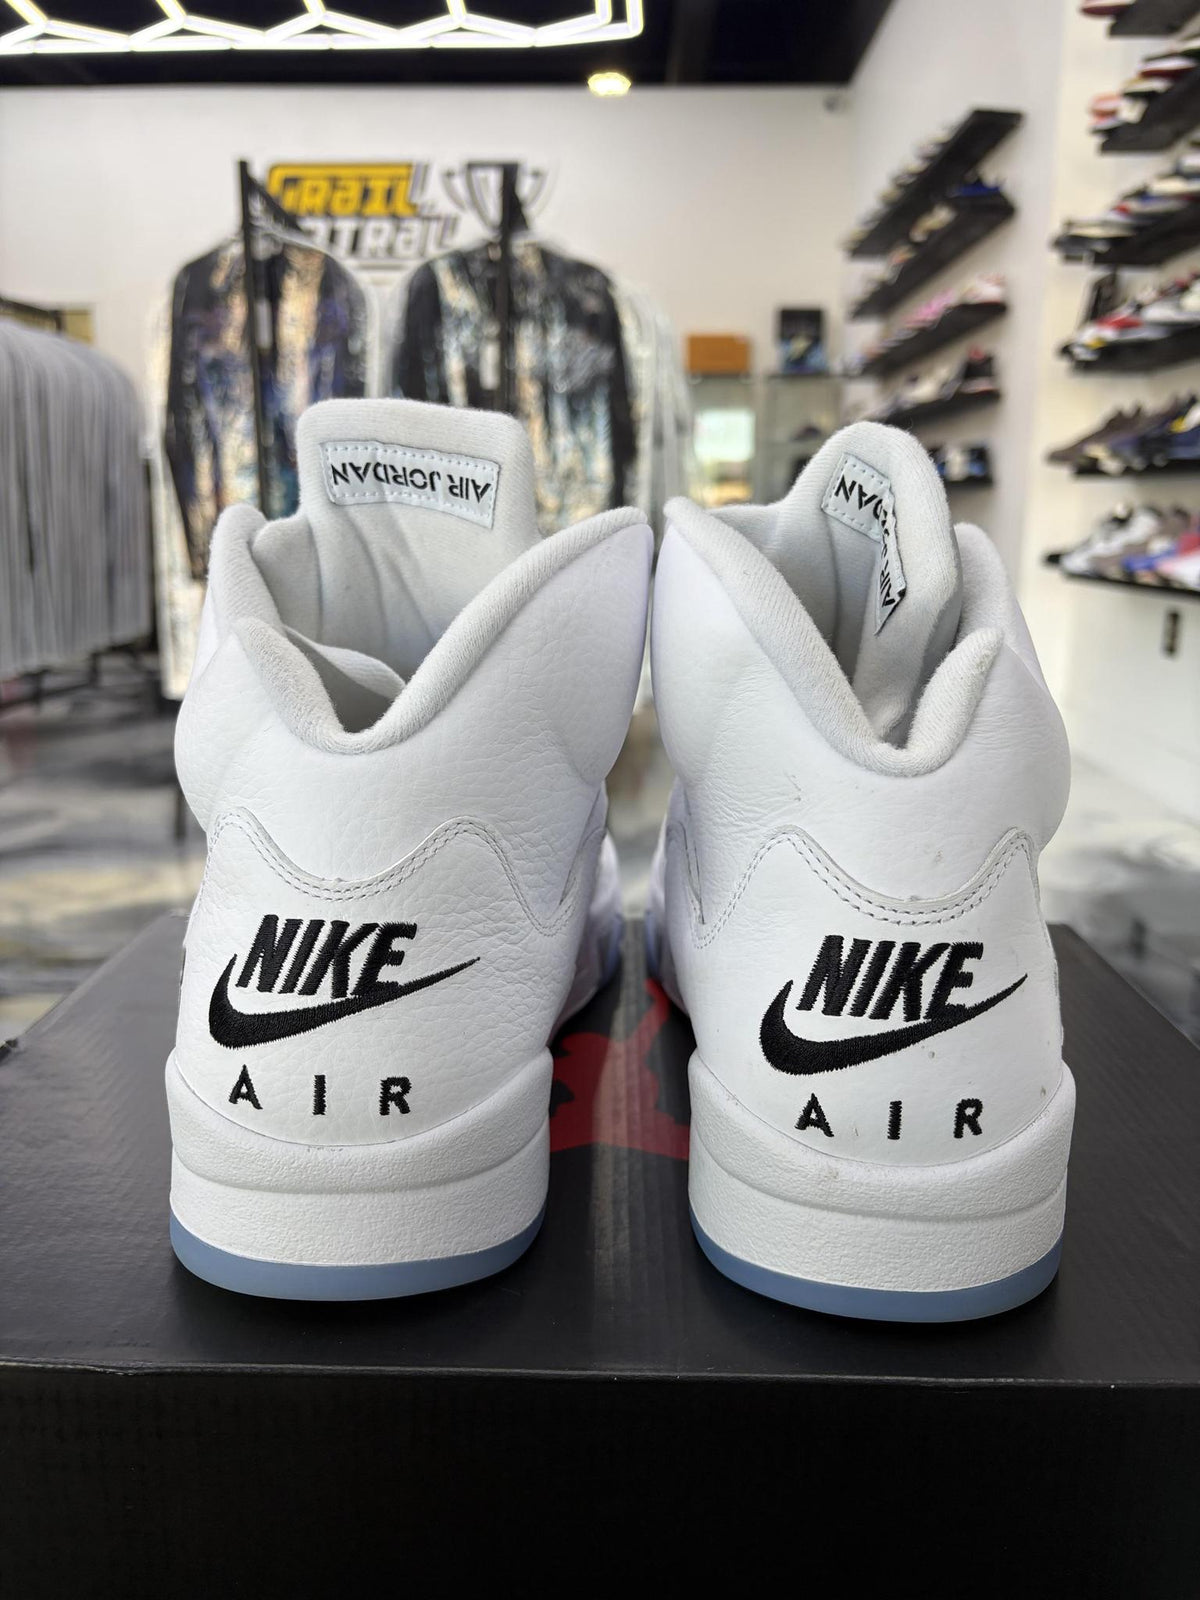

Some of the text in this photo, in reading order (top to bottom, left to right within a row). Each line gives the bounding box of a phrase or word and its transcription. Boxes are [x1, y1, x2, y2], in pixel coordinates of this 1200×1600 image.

[331, 462, 492, 503] AIR JORDAN
[235, 914, 417, 1000] NIKE
[796, 934, 984, 1022] NIKE
[229, 1064, 412, 1116] AIR
[795, 1092, 983, 1140] AIR
